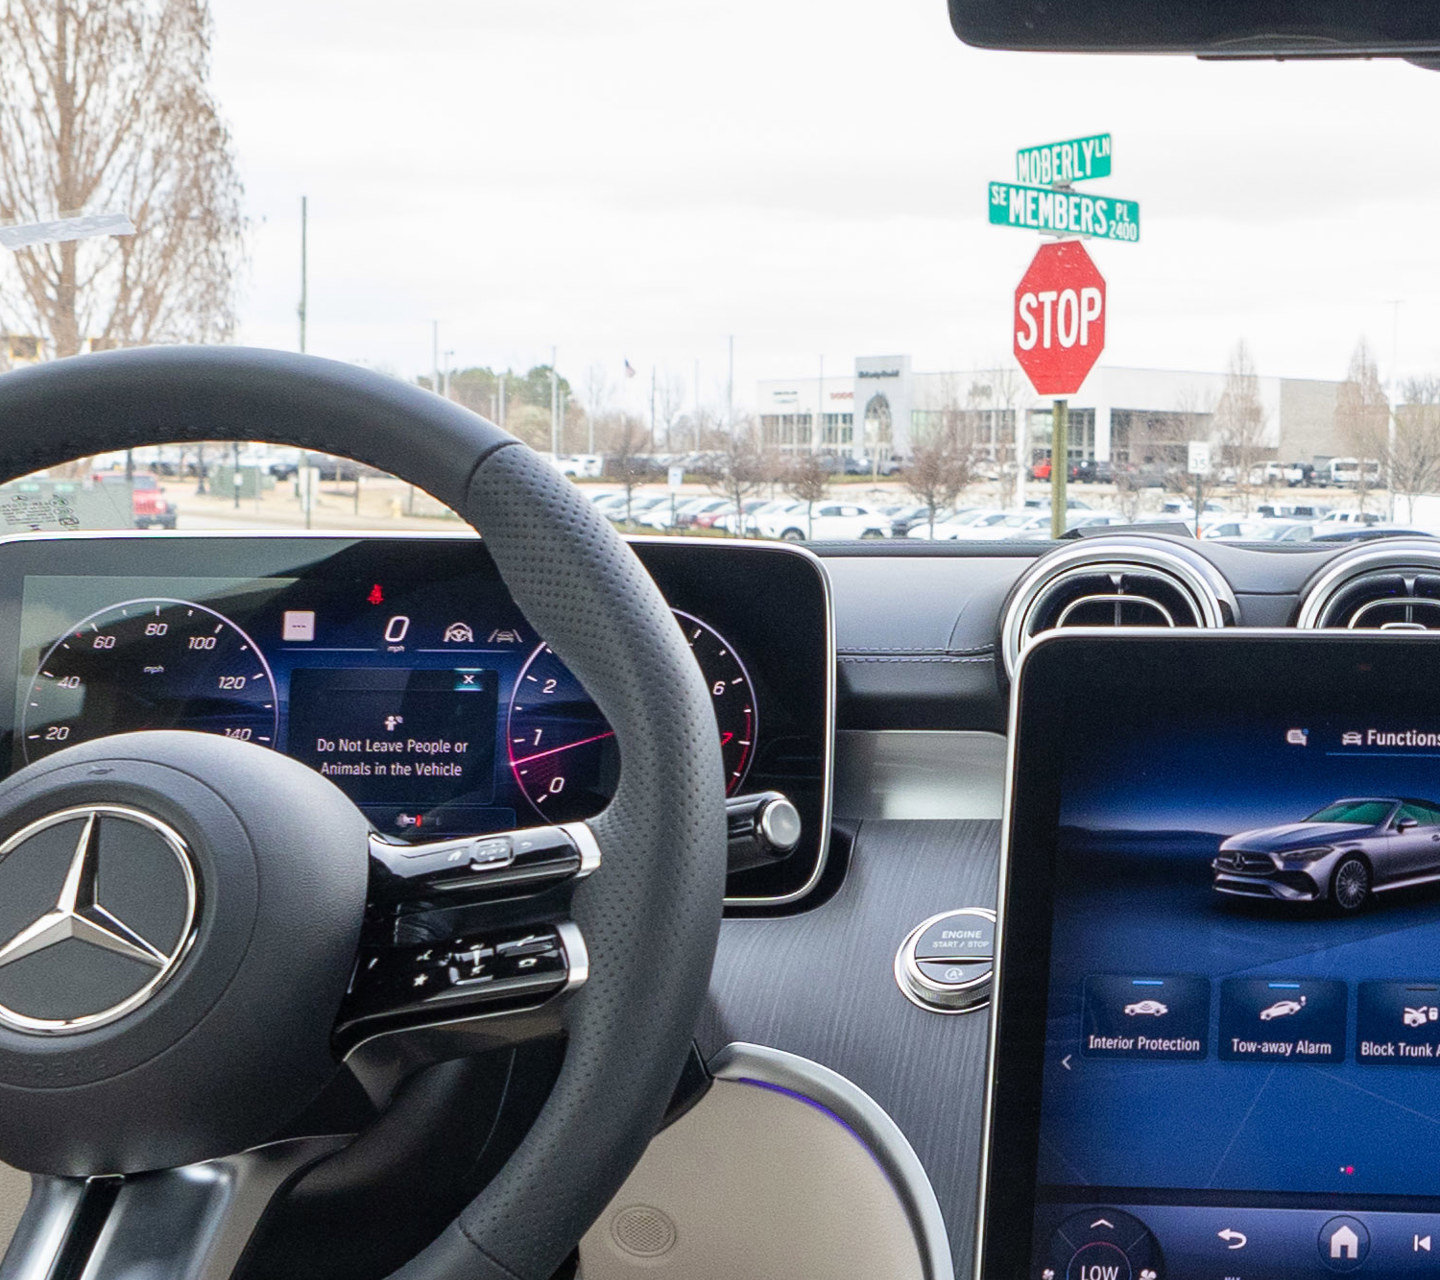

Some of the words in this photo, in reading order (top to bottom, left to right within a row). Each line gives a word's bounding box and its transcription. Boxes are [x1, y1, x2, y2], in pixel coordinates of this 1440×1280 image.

[1017, 138, 1095, 185] MOBERLY
[1095, 136, 1111, 158] LN
[991, 185, 1007, 206] SE
[1009, 187, 1108, 235] MEMBERS
[1115, 203, 1130, 222] PL
[1109, 220, 1138, 241] 2400
[1016, 286, 1103, 351] STOP
[144, 623, 168, 636] 80
[384, 615, 410, 643] 0
[92, 636, 116, 649] 60
[188, 636, 217, 650] 100
[387, 645, 406, 654] mph
[143, 664, 165, 674] mph
[57, 675, 80, 689] 40
[218, 676, 246, 690] 120
[542, 678, 558, 694] 2
[713, 681, 726, 695] 6
[44, 726, 70, 741] 20
[223, 728, 252, 741] 140
[533, 729, 543, 747] 1
[720, 731, 734, 747] 7
[316, 738, 335, 753] Do
[338, 738, 362, 753] Not
[365, 738, 404, 753] Leave
[407, 738, 452, 756] People
[454, 741, 469, 753] or
[320, 762, 372, 776] Animals
[374, 762, 388, 776] in
[390, 762, 412, 777] the
[415, 762, 463, 777] Vehicle
[549, 777, 565, 794] 0
[1088, 1034, 1134, 1051] Interior
[1137, 1036, 1201, 1052] Protection
[1231, 1038, 1293, 1056] Tow-away
[1295, 1040, 1332, 1055] Alarm
[1361, 1041, 1395, 1057] Block
[1398, 1042, 1433, 1058] Trunk
